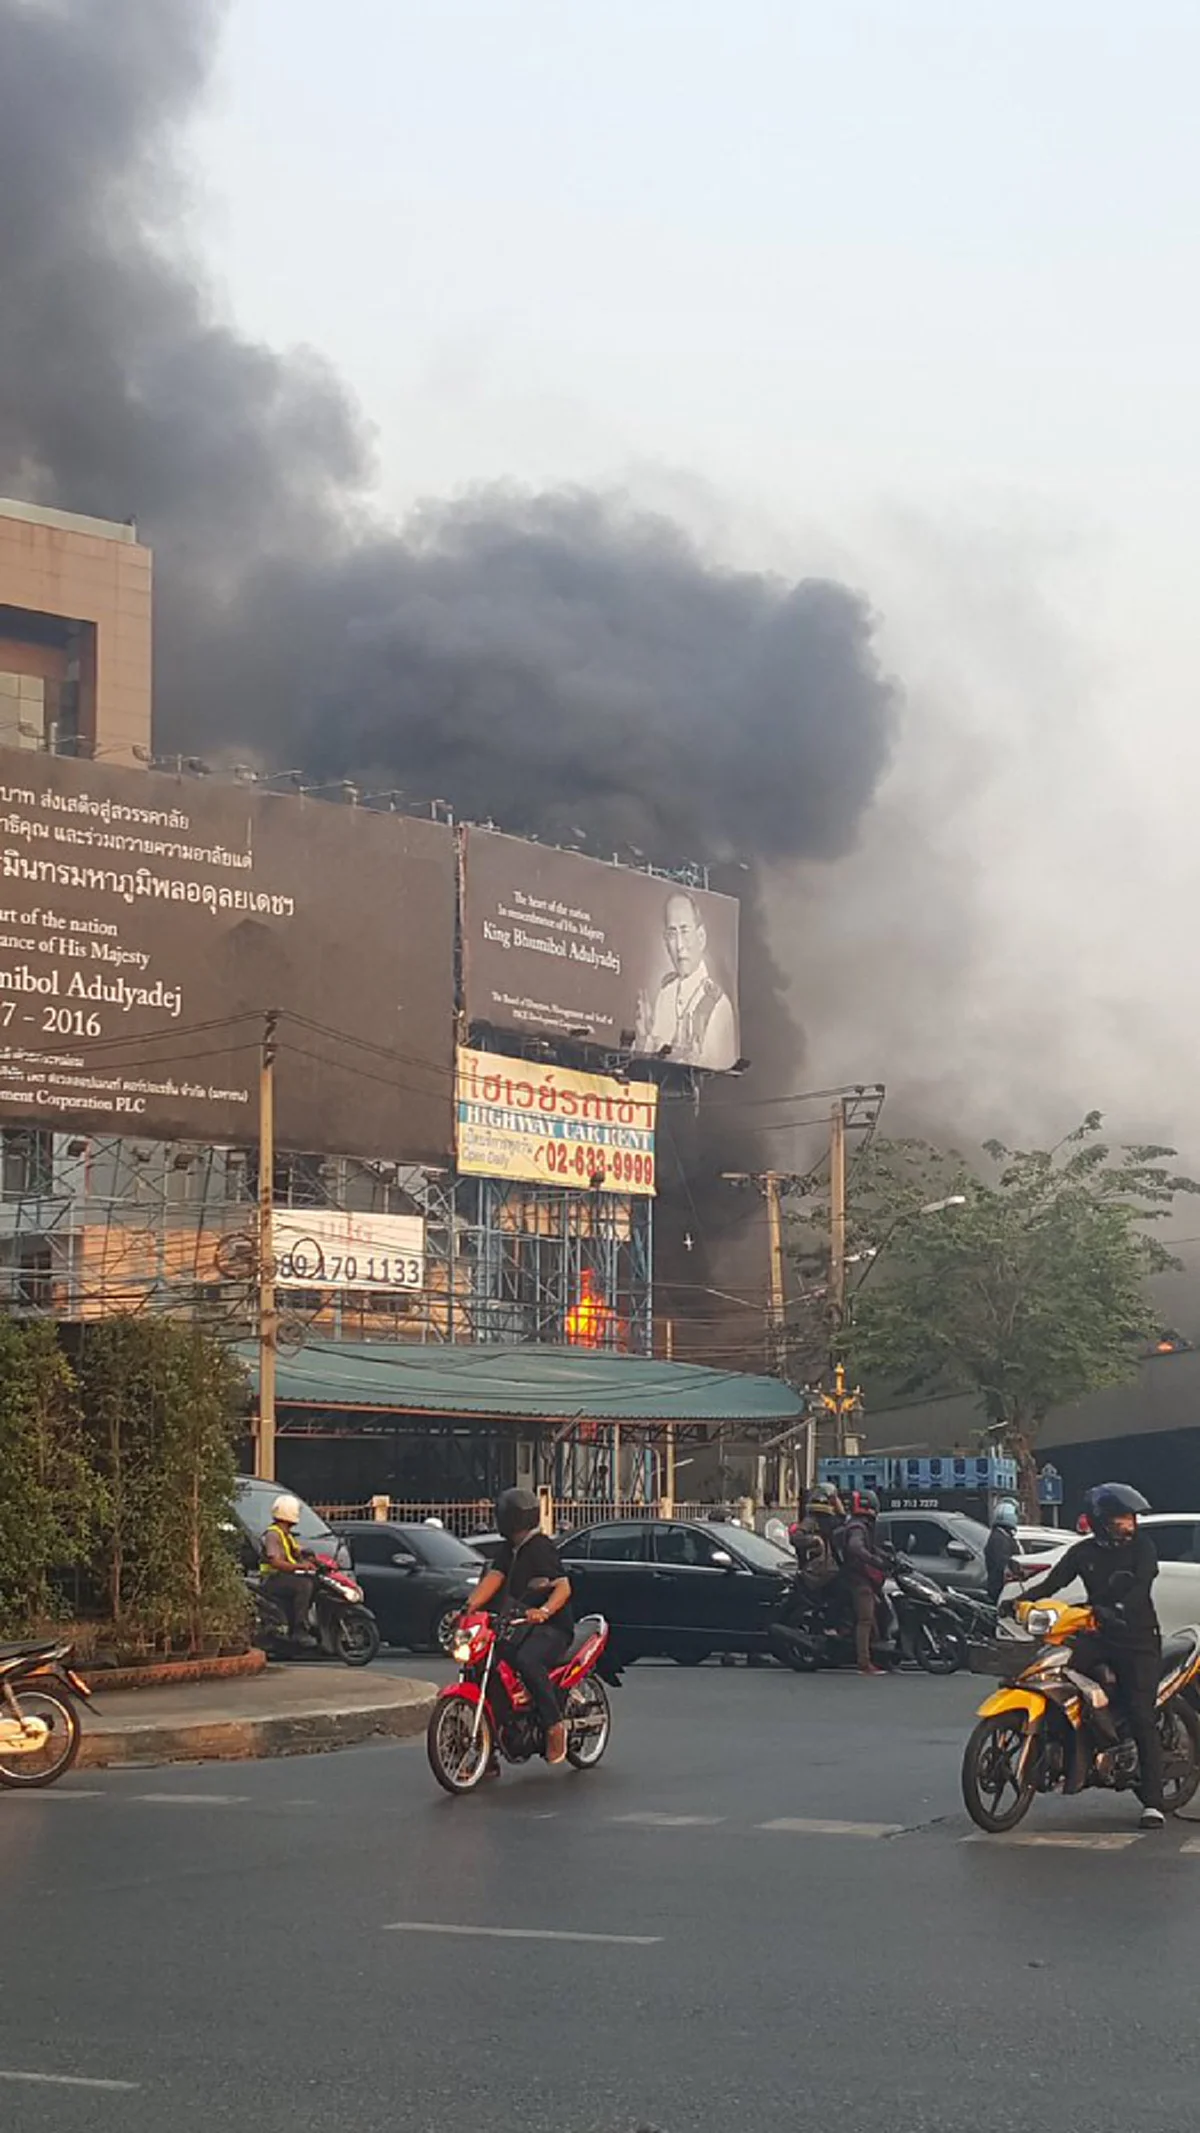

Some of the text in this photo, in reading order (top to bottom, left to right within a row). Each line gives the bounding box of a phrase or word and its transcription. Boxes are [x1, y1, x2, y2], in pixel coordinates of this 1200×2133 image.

[0, 848, 295, 917] มินทรมหาภูมิพลอดุลยเดชฯ
[21, 908, 41, 926] of
[42, 911, 66, 929] the
[70, 918, 118, 936] nation
[39, 936, 58, 953] of
[59, 938, 87, 957] His
[91, 941, 150, 970] Majesty
[483, 920, 620, 975] King Bhumibol Adulyadej
[66, 971, 182, 1018] Adulyadej
[42, 1006, 101, 1037] 2016
[36, 1089, 113, 1111] Corporation
[116, 1096, 146, 1113] PLC
[466, 1105, 557, 1138] HIGHWAY
[602, 1128, 651, 1151] RENT
[317, 1255, 358, 1281] 170
[367, 1257, 420, 1284] 1133
